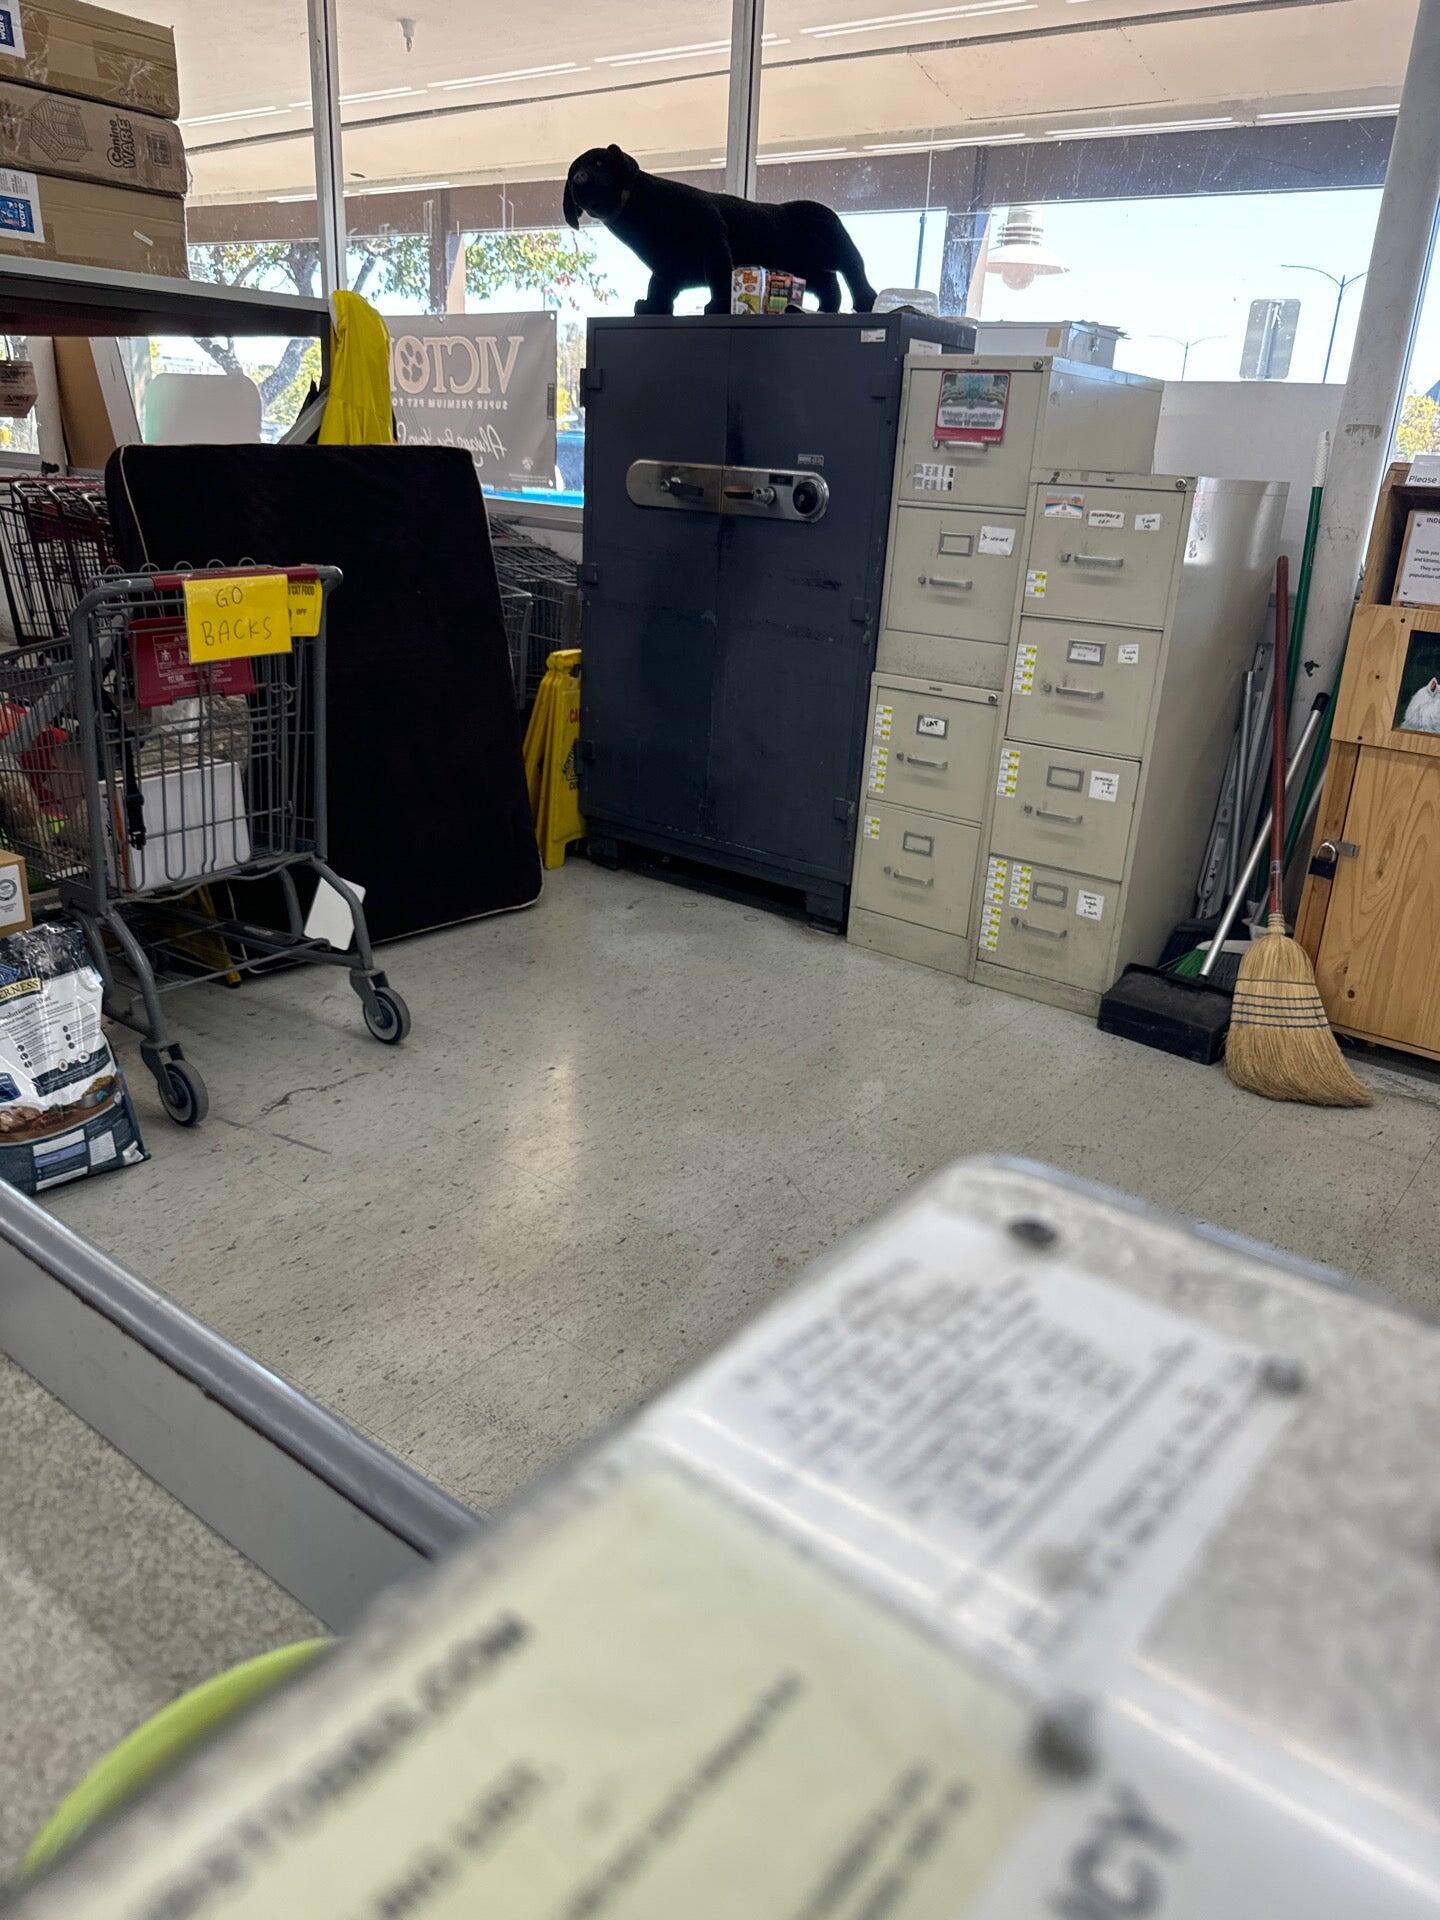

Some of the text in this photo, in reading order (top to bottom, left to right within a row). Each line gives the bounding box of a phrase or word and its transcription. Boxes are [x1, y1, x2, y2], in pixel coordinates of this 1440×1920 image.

[106, 119, 123, 168] Canine
[120, 118, 136, 169] WARE
[18, 202, 27, 228] ware
[1408, 475, 1438, 484] Please
[216, 586, 244, 609] GO
[301, 585, 315, 597] FOOD
[201, 615, 273, 647] BACKS
